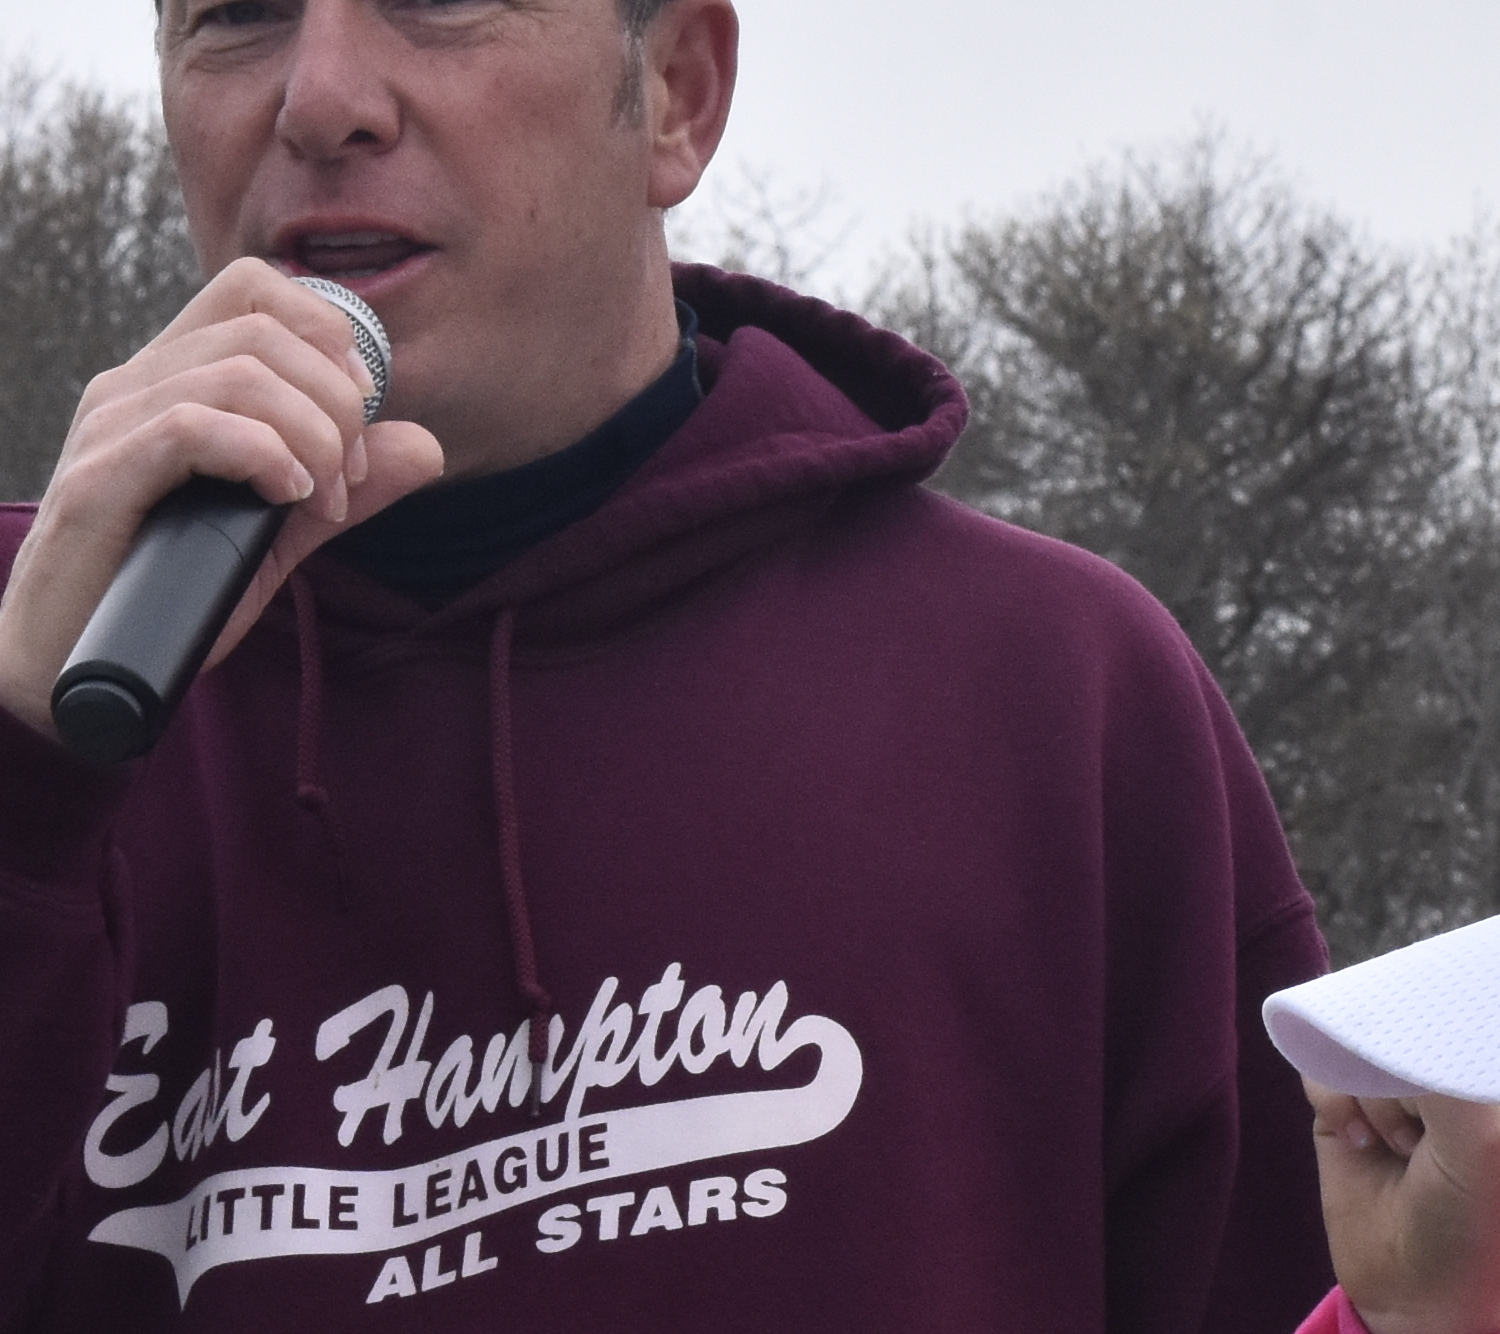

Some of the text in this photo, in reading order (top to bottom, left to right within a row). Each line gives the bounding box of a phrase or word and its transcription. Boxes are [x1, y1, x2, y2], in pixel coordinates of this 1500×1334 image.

[315, 962, 791, 1147] Hampton
[185, 1122, 610, 1252] LITTLE LEAGUE
[366, 1168, 788, 1304] ALL STARS
